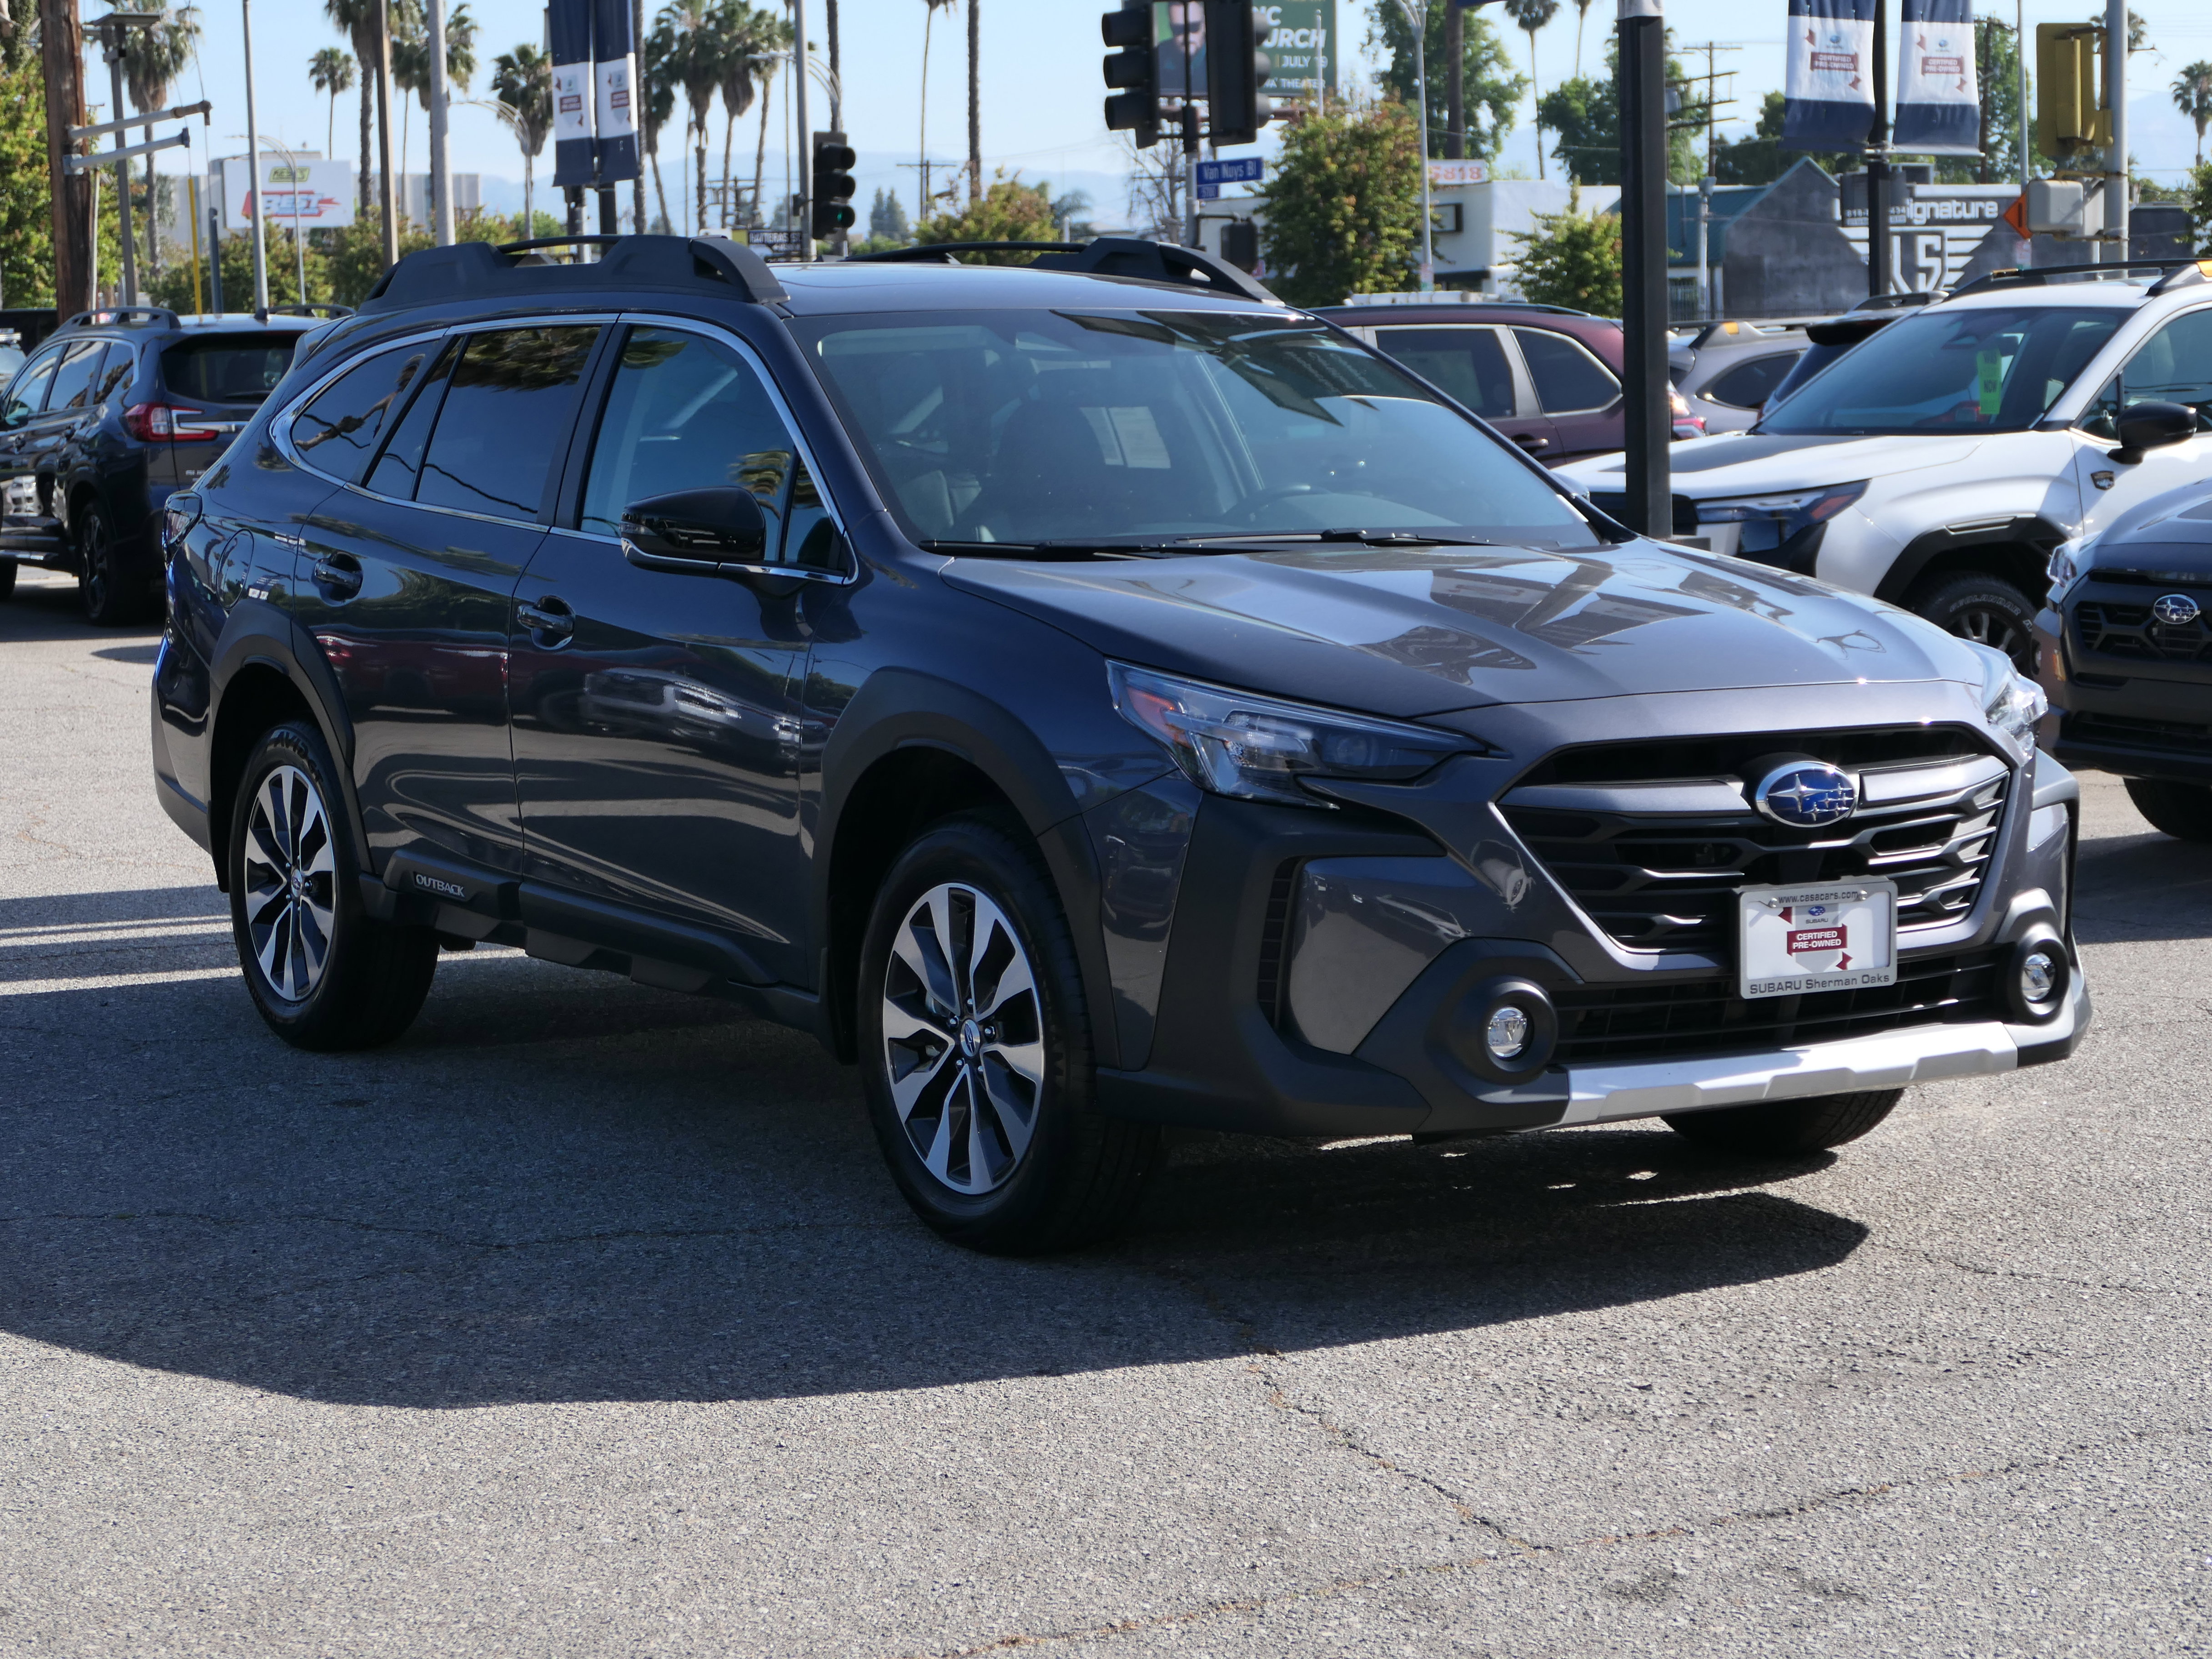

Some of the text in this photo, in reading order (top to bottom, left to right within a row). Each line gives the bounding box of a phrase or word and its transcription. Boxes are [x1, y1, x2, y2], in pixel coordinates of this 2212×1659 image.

[1262, 28, 1327, 49] URCH
[1281, 55, 1311, 68] JULY
[1203, 161, 1256, 181] Van Nuys Bl
[1905, 197, 1998, 225] ignature
[416, 874, 465, 897] OUTBACK
[1778, 890, 1859, 904] www.casacars.com
[1792, 939, 1841, 950] PRE-OWNED
[1796, 930, 1837, 941] CERTIFIED
[1750, 974, 1890, 994] SUBARU Sherman Oaks
